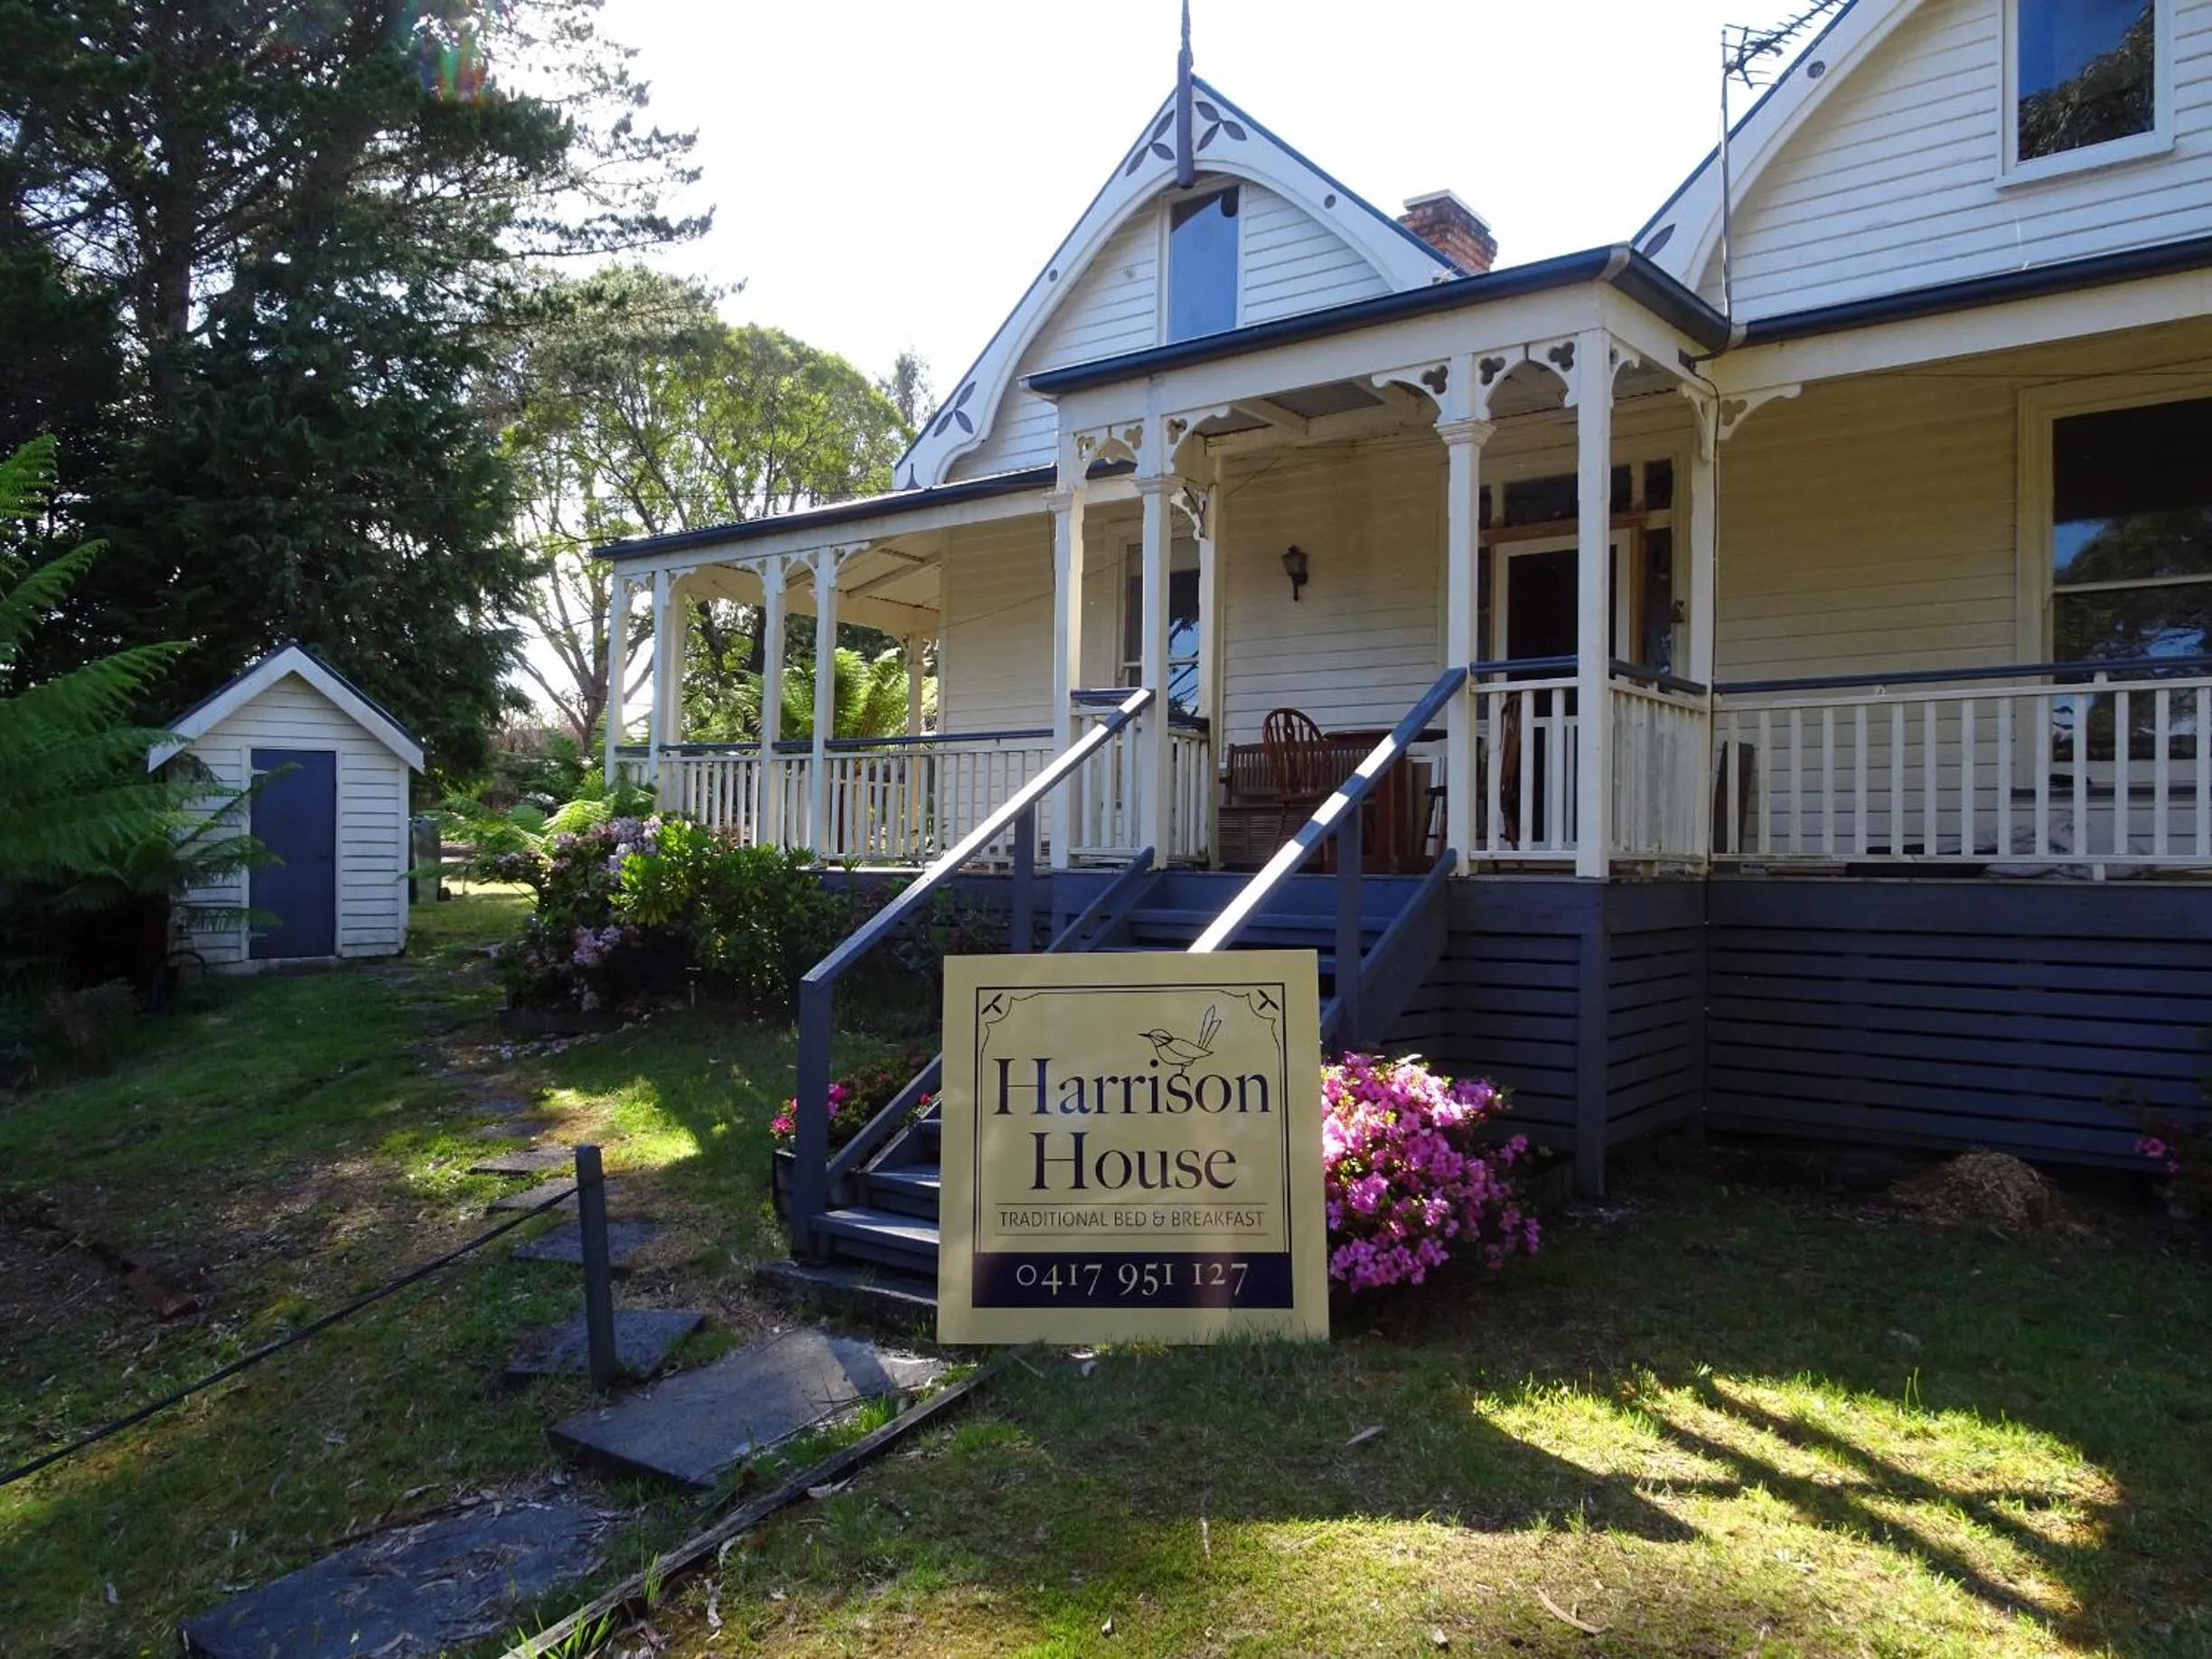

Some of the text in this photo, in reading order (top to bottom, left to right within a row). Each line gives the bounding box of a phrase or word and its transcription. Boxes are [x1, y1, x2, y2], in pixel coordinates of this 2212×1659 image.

[993, 1057, 1271, 1115] Harrison
[1029, 1132, 1237, 1190] House
[999, 1211, 1265, 1227] TRADITIONAL BED & BREAKFAST
[1016, 1262, 1249, 1297] 0417 951 127
